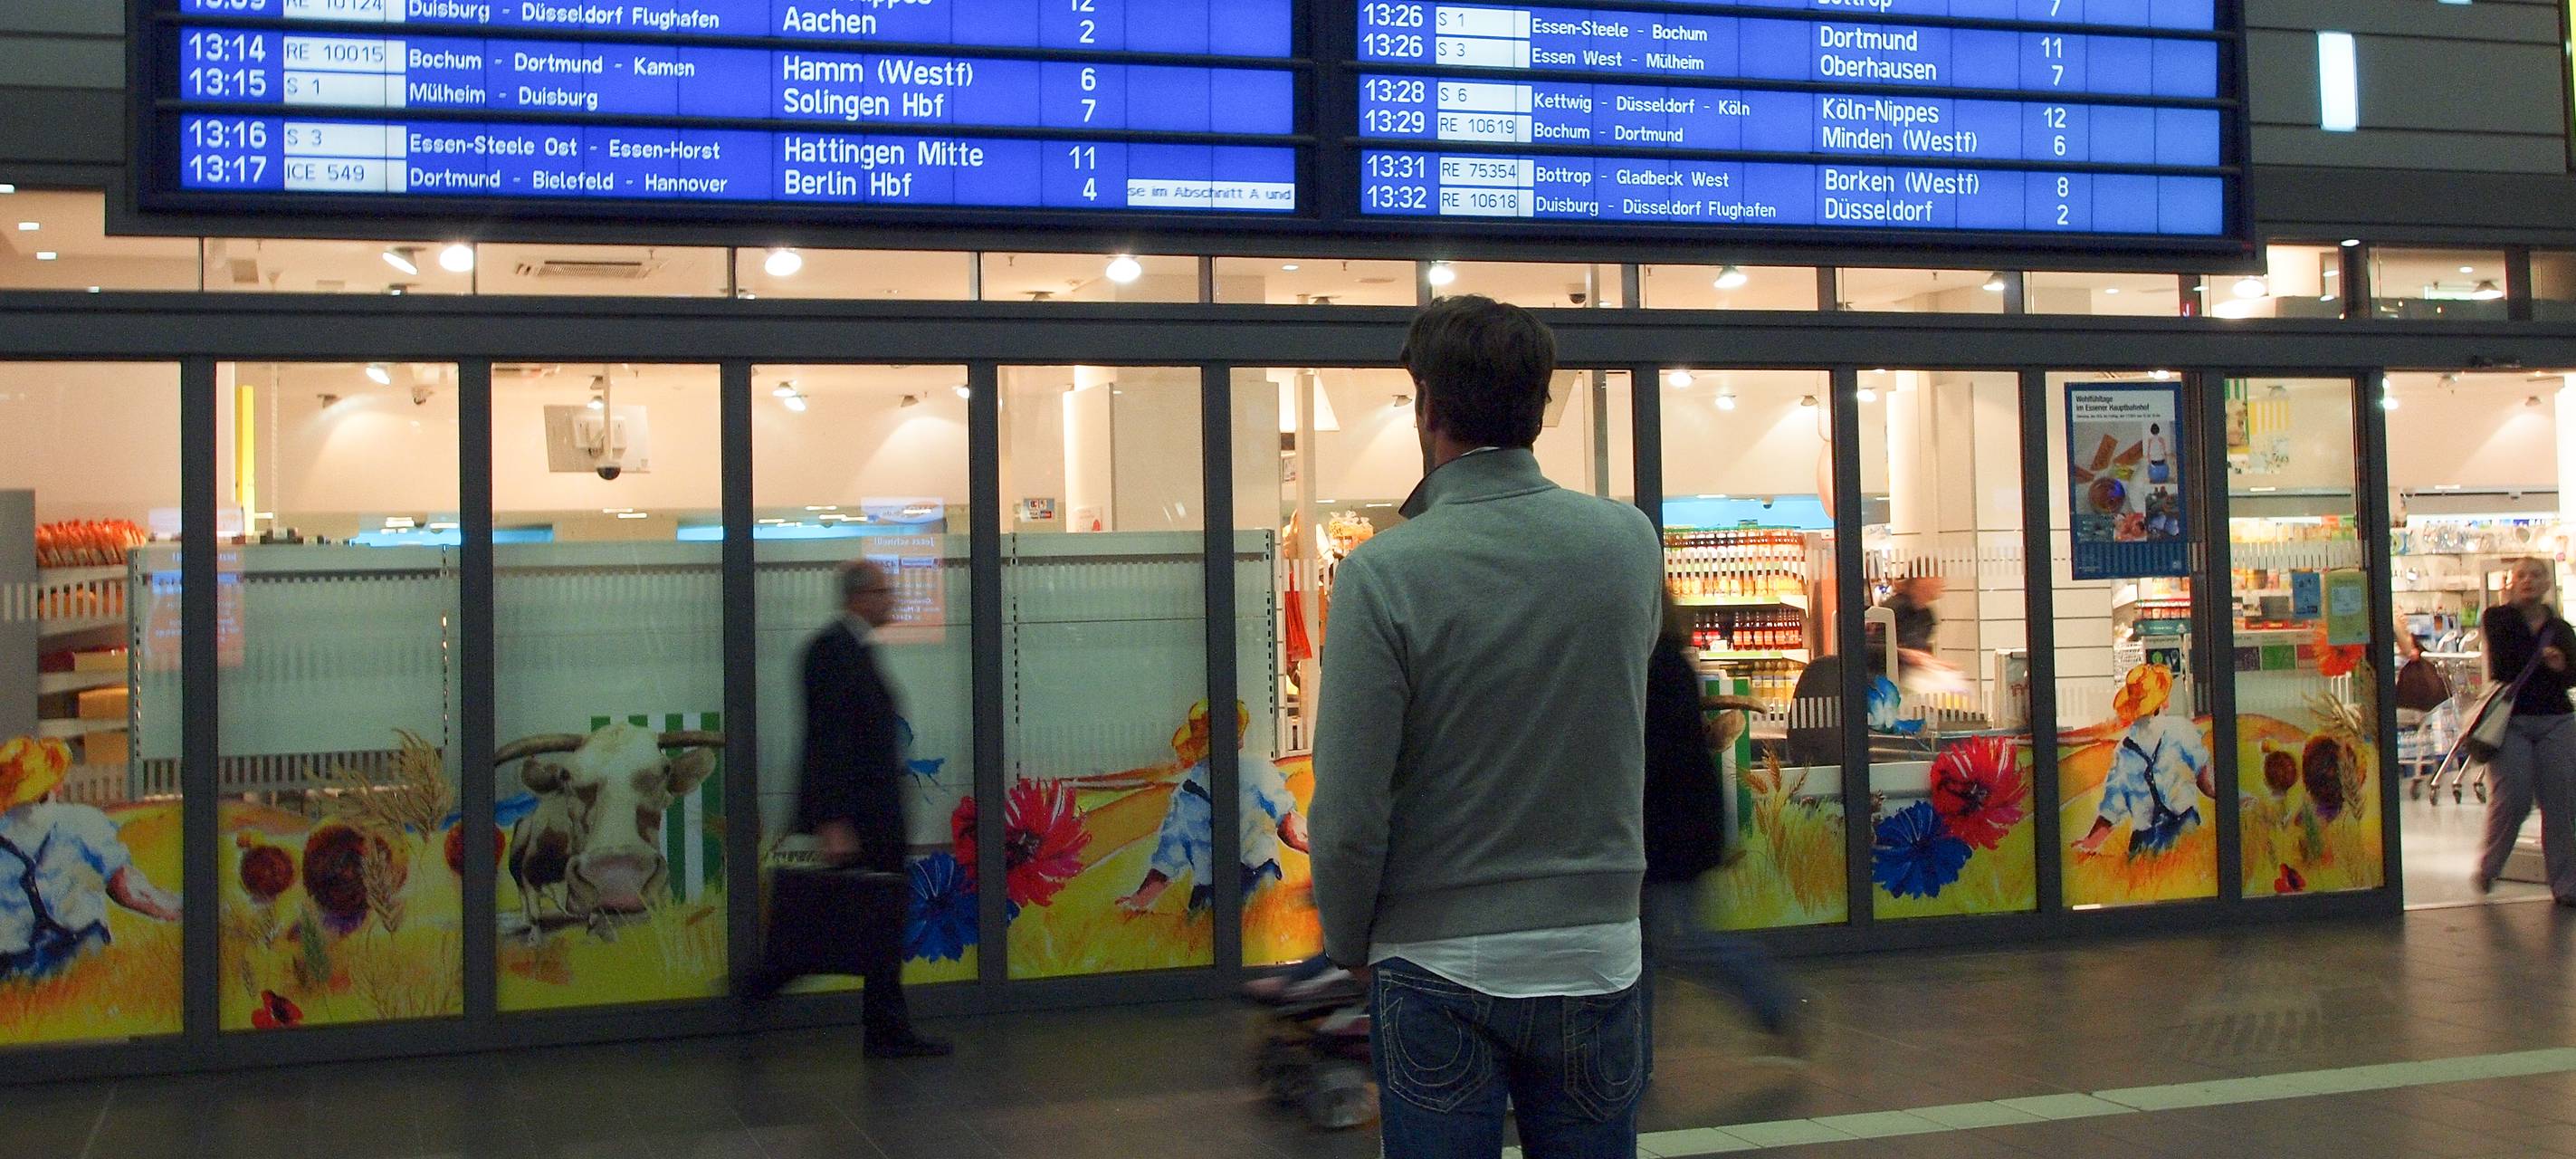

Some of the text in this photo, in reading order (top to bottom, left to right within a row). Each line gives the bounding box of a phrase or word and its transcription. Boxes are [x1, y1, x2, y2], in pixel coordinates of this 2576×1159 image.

[409, 0, 490, 22] Duisburg
[521, 2, 623, 24] Düsseldorf
[632, 6, 720, 30] Flughafen
[782, 5, 877, 34] Aachen
[1363, 3, 1424, 27] 13:26
[1437, 11, 1465, 27] S 1
[1080, 19, 1095, 43] 2
[1532, 17, 1628, 38] Essen-Steele
[1652, 24, 1708, 42] Bochum
[1820, 25, 1918, 52] Dortmund
[189, 33, 266, 62] 13:14
[286, 43, 384, 62] RE 10015
[1363, 33, 1423, 58] 13:26
[1437, 42, 1465, 58] S 3
[2041, 37, 2062, 59] 11
[409, 49, 482, 70] Bochum
[514, 53, 603, 73] Dortmund
[634, 56, 695, 77] Kamen
[1532, 47, 1576, 64] Essen
[1583, 50, 1623, 67] West
[1646, 53, 1704, 70] Mülheim
[1820, 54, 1937, 81] Oberhausen
[189, 68, 266, 95] 13:15
[784, 55, 973, 87] Hamm (Westf)
[1081, 67, 1096, 91] 6
[2051, 64, 2064, 86] 7
[286, 77, 320, 96] S 1
[409, 82, 485, 103] Mülheim
[519, 86, 598, 110] Duisburg
[1365, 79, 1425, 103] 13:28
[1439, 87, 1468, 102] S 6
[784, 88, 944, 121] Solingen Hbf
[1081, 99, 1096, 122] 7
[1534, 92, 1592, 113] Kettwig
[1617, 96, 1695, 113] Düsseldorf
[1718, 100, 1751, 116] Köln
[1822, 98, 1939, 128] Köln-Nippes
[1365, 109, 1425, 133] 13:29
[1439, 117, 1514, 134] RE 10619
[2044, 107, 2066, 129] 12
[190, 120, 267, 148] 13:16
[286, 128, 322, 146] S 3
[1534, 122, 1590, 139] Bochum
[1615, 125, 1684, 142] Dortmund
[1822, 126, 1978, 153] Minden (Westf)
[410, 133, 535, 155] Essen-Steele
[545, 138, 577, 156] Ost
[609, 139, 720, 159] Essen-Horst
[785, 137, 984, 169] Hattingen Mitte
[1069, 146, 1095, 169] 11
[2054, 135, 2066, 156] 6
[190, 155, 267, 182] 13:17
[286, 163, 365, 182] ICE 549
[1367, 155, 1425, 178] 13:31
[1441, 162, 1516, 179] RE 75354
[1536, 167, 1591, 187] Bottrop
[1617, 169, 1684, 186] Gladbeck
[1691, 171, 1729, 187] West
[410, 168, 501, 187] Dortmund
[533, 170, 614, 190] Bielefeld
[645, 173, 728, 192] Hannover
[785, 169, 912, 196] Berlin Hbf
[1083, 177, 1097, 201] 4
[1825, 168, 1980, 195] Borken (Westf)
[2056, 177, 2069, 197] 8
[1367, 185, 1426, 208] 13:32
[1441, 192, 1516, 209] RE 10618
[1536, 196, 1598, 216] Duisburg
[1623, 198, 1702, 216] Düsseldorf
[1708, 201, 1776, 220] Flughafen
[1825, 197, 1932, 222] Düsseldorf
[2056, 204, 2068, 225] 2
